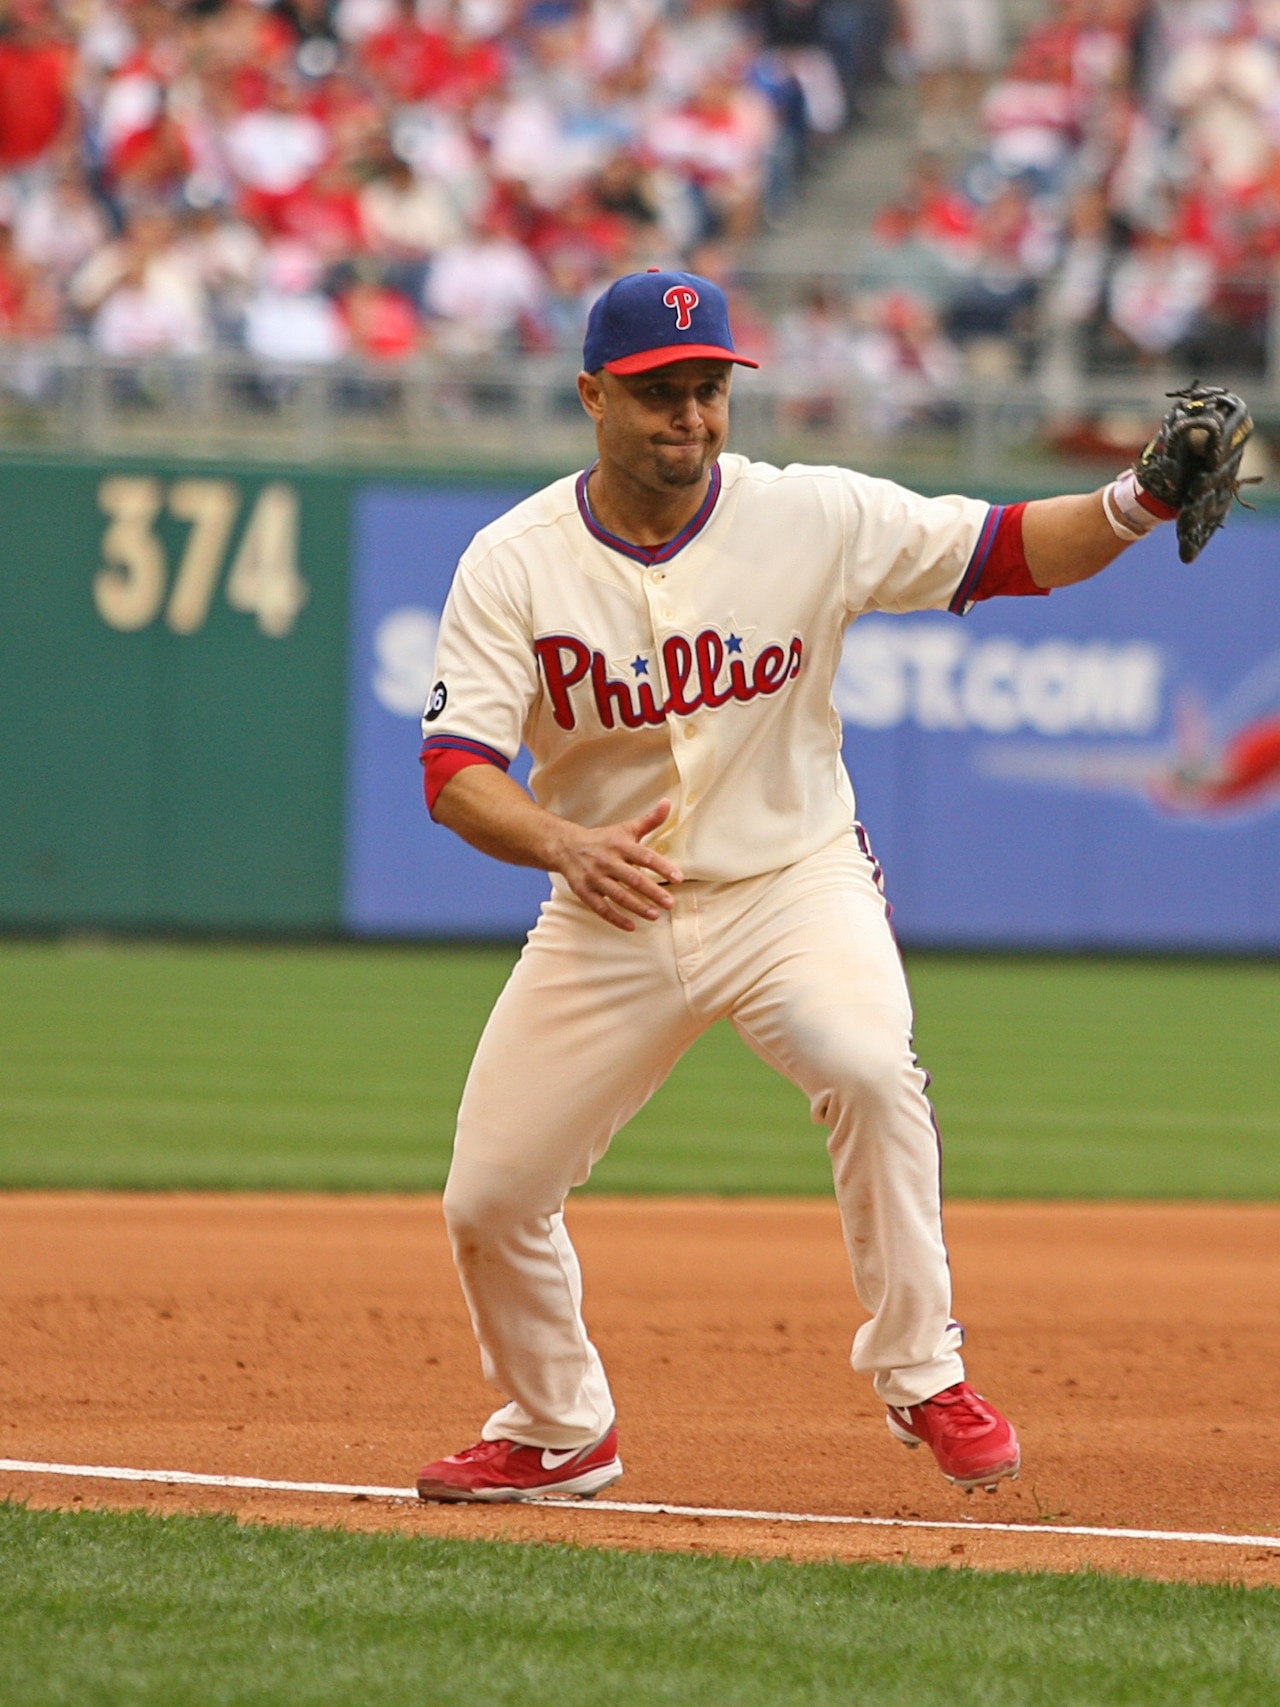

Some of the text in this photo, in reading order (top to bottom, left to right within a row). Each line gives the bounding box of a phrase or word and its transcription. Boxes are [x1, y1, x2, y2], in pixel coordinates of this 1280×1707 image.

[663, 286, 699, 330] P
[93, 474, 311, 638] 374
[534, 629, 803, 730] Phillies
